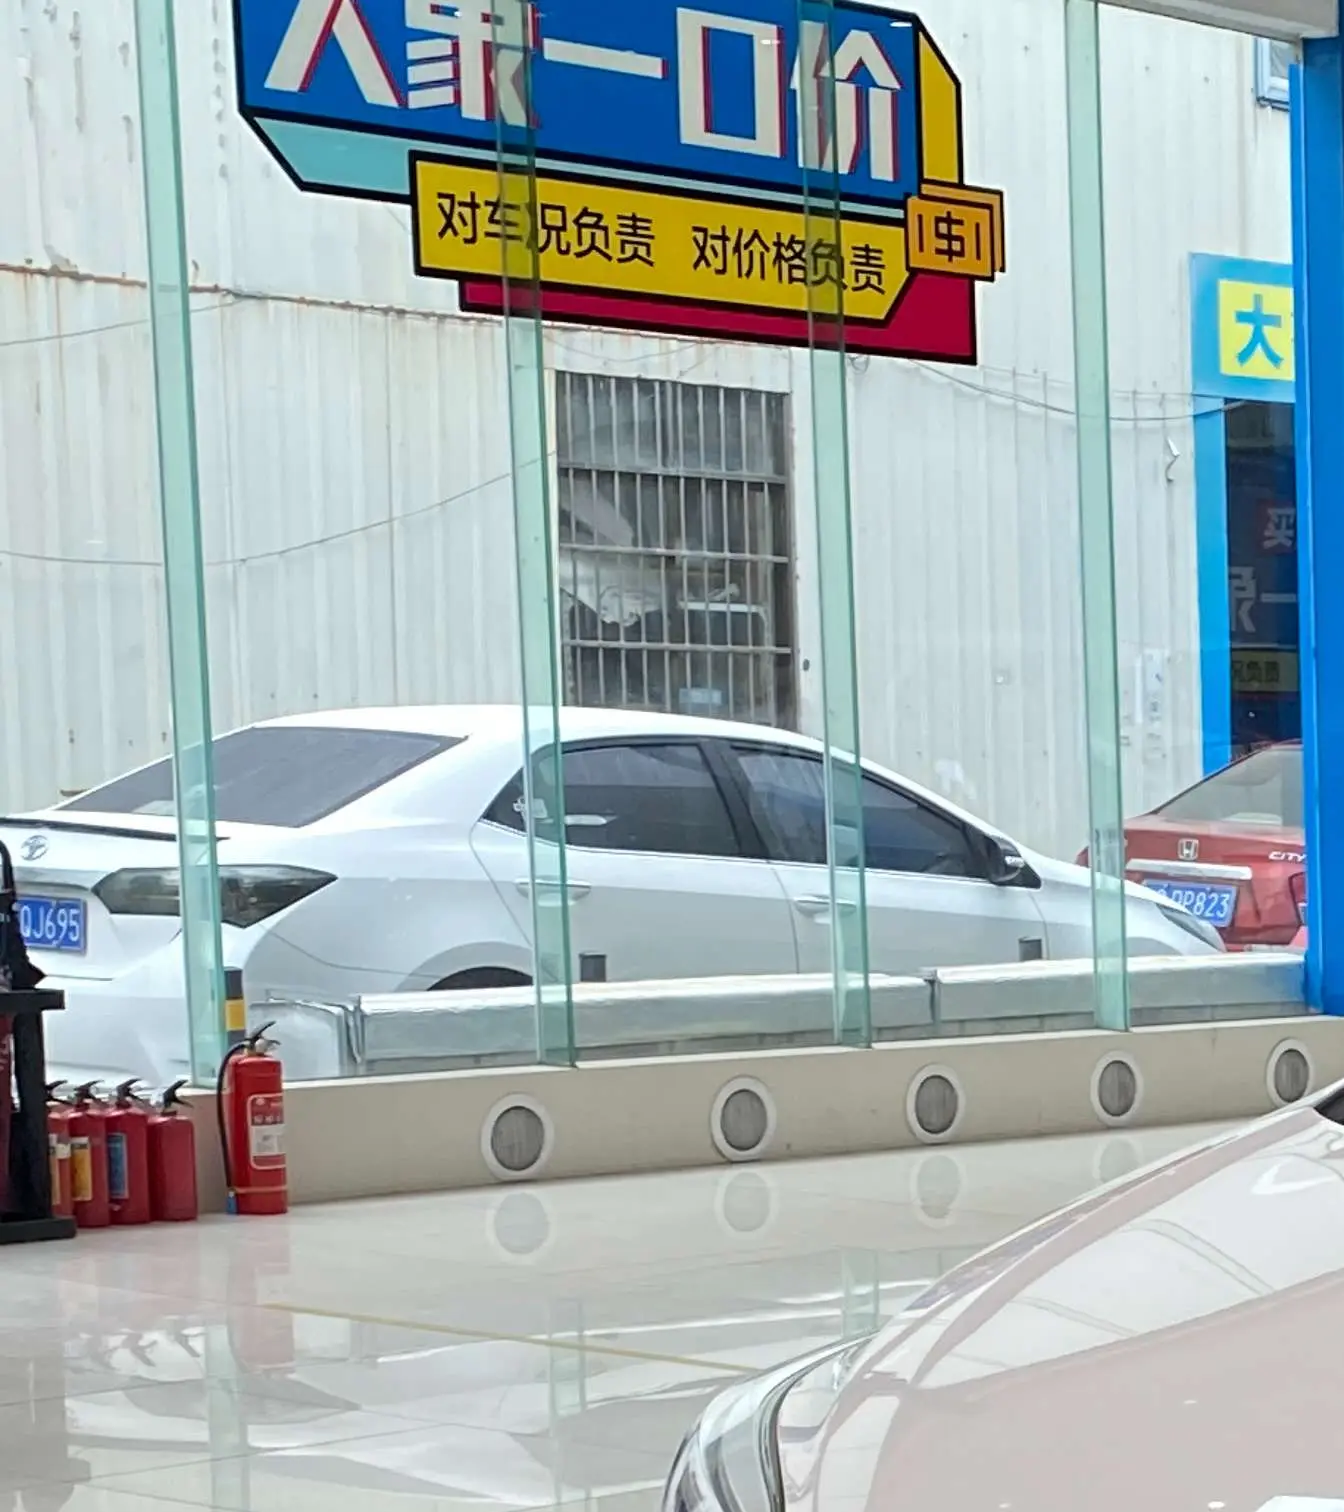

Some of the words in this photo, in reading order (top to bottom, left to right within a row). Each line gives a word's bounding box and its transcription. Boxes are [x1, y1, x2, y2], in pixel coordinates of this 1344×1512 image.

[437, 190, 655, 268] 对车况负责
[691, 224, 887, 296] 对价格负责
